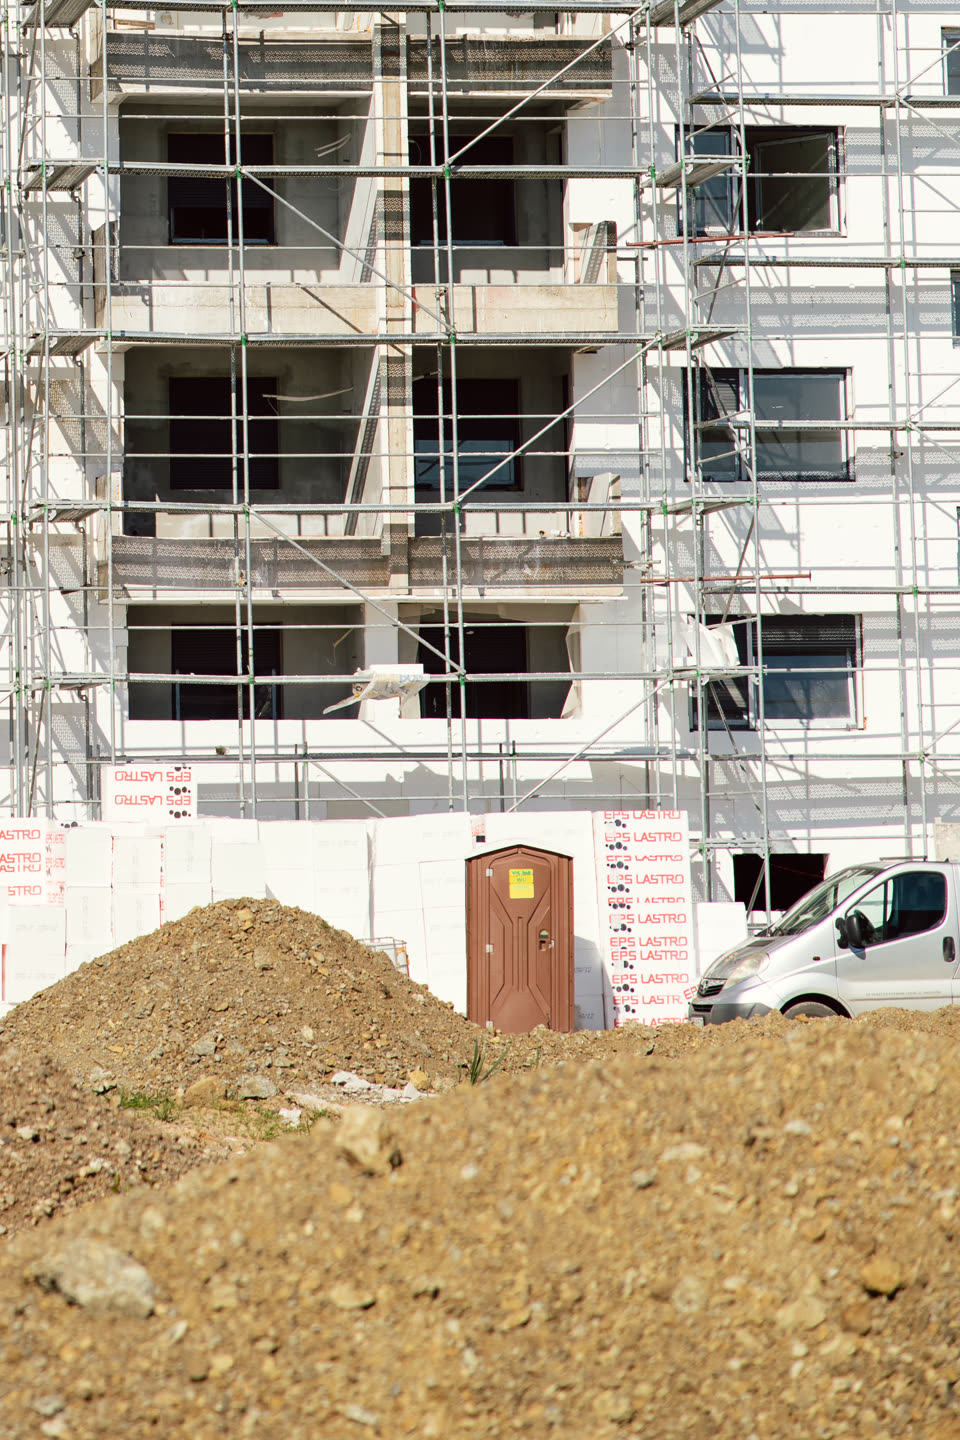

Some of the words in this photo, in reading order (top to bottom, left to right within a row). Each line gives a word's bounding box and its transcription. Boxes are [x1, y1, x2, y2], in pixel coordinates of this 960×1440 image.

[114, 771, 163, 782] LASTRO
[166, 771, 191, 782] EPS
[114, 795, 163, 806] LASTRO
[166, 795, 191, 806] EPS
[604, 810, 629, 819] EPS
[633, 810, 681, 819] LASTRO
[634, 832, 682, 842] LASTRO
[636, 874, 684, 884] LASTRO
[638, 913, 687, 923] LASTRO
[610, 937, 636, 947] EPS
[639, 936, 688, 946] LASTRO
[611, 951, 637, 961] EPS
[640, 950, 688, 960] LASTRO
[612, 974, 637, 984] EPS
[641, 973, 689, 984] LASTRO
[683, 984, 699, 1000] EP
[613, 995, 639, 1005] EPS
